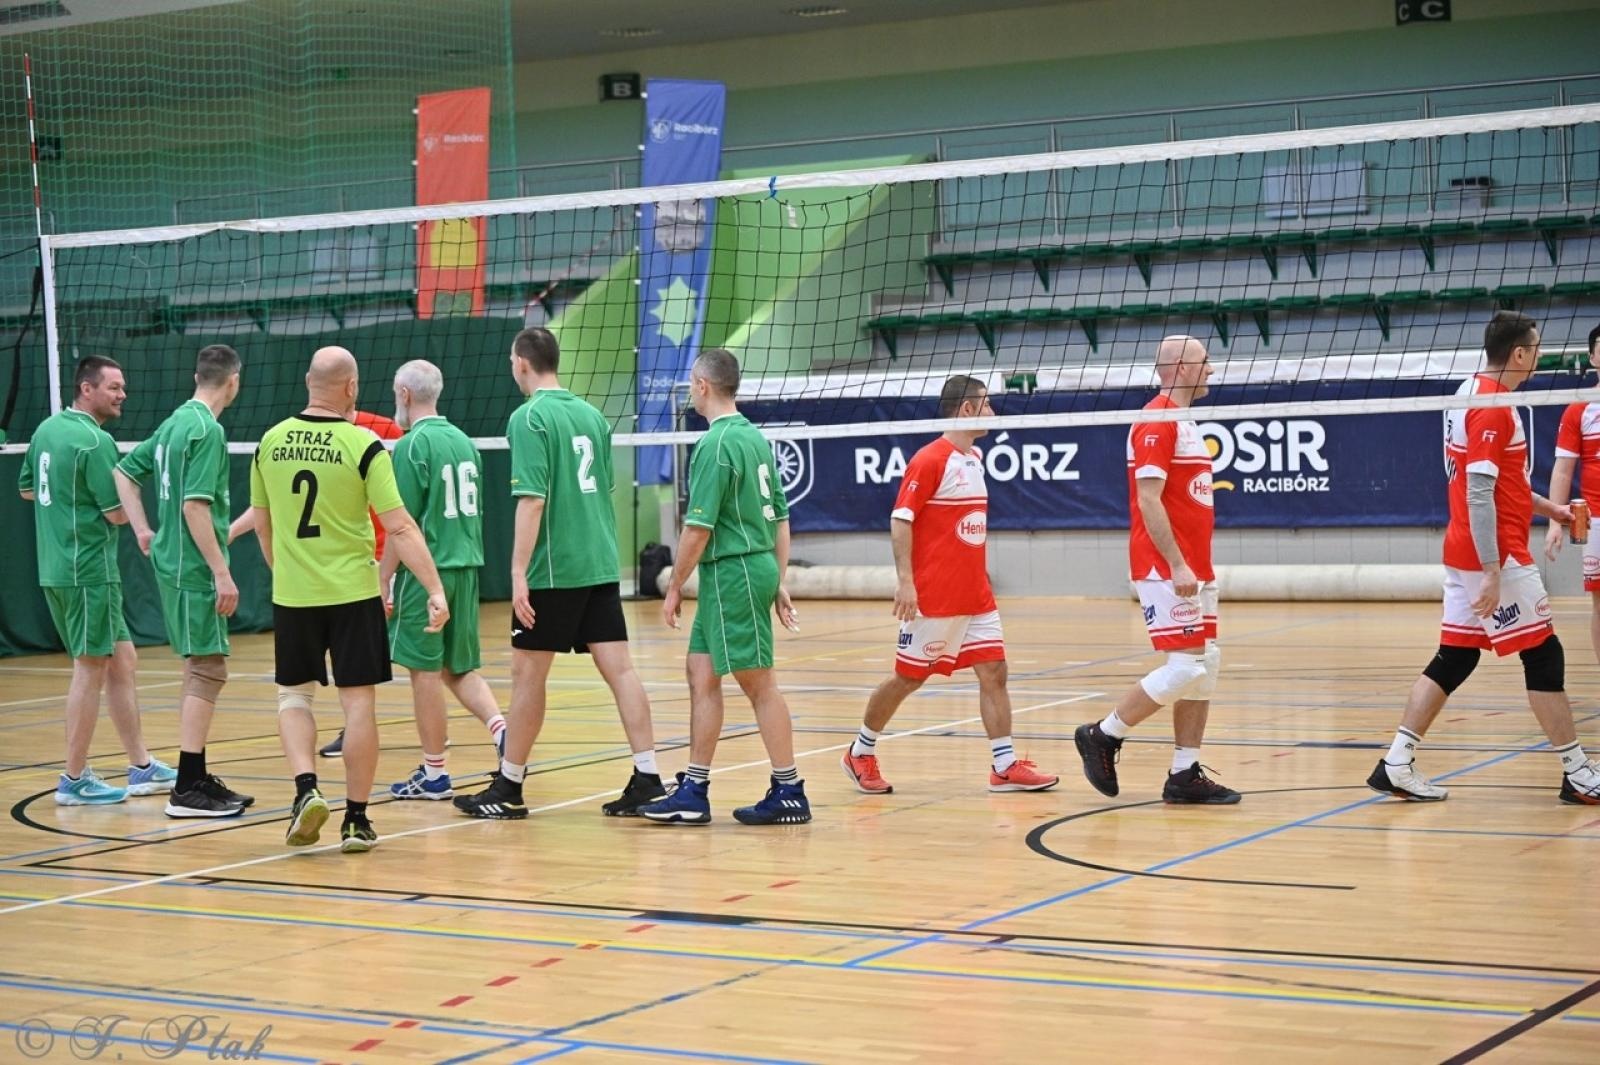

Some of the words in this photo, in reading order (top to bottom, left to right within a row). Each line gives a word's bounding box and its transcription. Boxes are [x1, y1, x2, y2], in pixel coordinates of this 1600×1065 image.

[1399, 4, 1409, 20] C
[1421, 1, 1444, 18] C
[613, 83, 631, 96] B
[285, 430, 333, 446] STRAŻ
[272, 447, 342, 465] GRANICZNA
[572, 435, 597, 494] 2
[855, 431, 1080, 484] RAÓRZ
[441, 461, 479, 519] 16
[1243, 474, 1330, 493] RACIBÓRZ
[291, 469, 321, 539] 2
[1492, 602, 1521, 630] Silan
